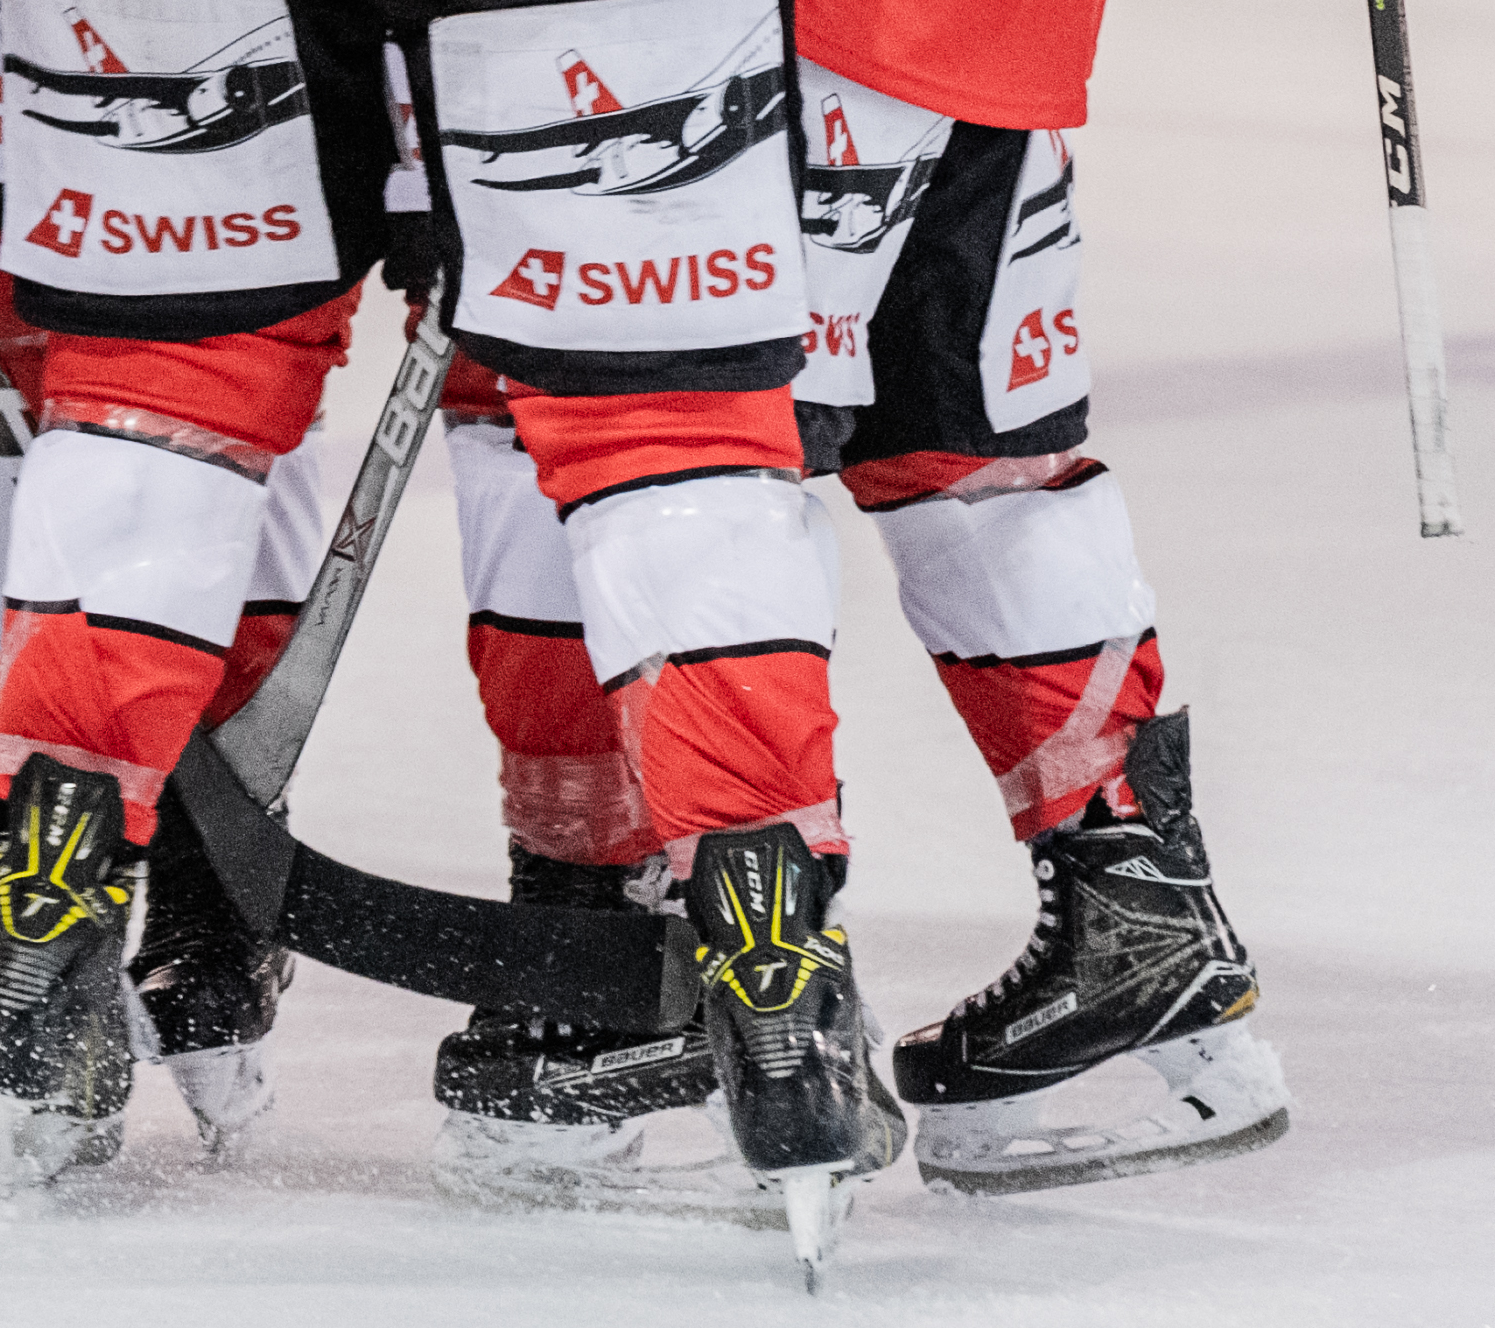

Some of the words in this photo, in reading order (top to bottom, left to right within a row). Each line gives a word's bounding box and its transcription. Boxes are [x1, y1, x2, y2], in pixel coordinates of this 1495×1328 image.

[1377, 74, 1412, 208] CM
[100, 200, 302, 257] SWISS
[576, 241, 778, 309] SWISS
[743, 849, 767, 914] CCM
